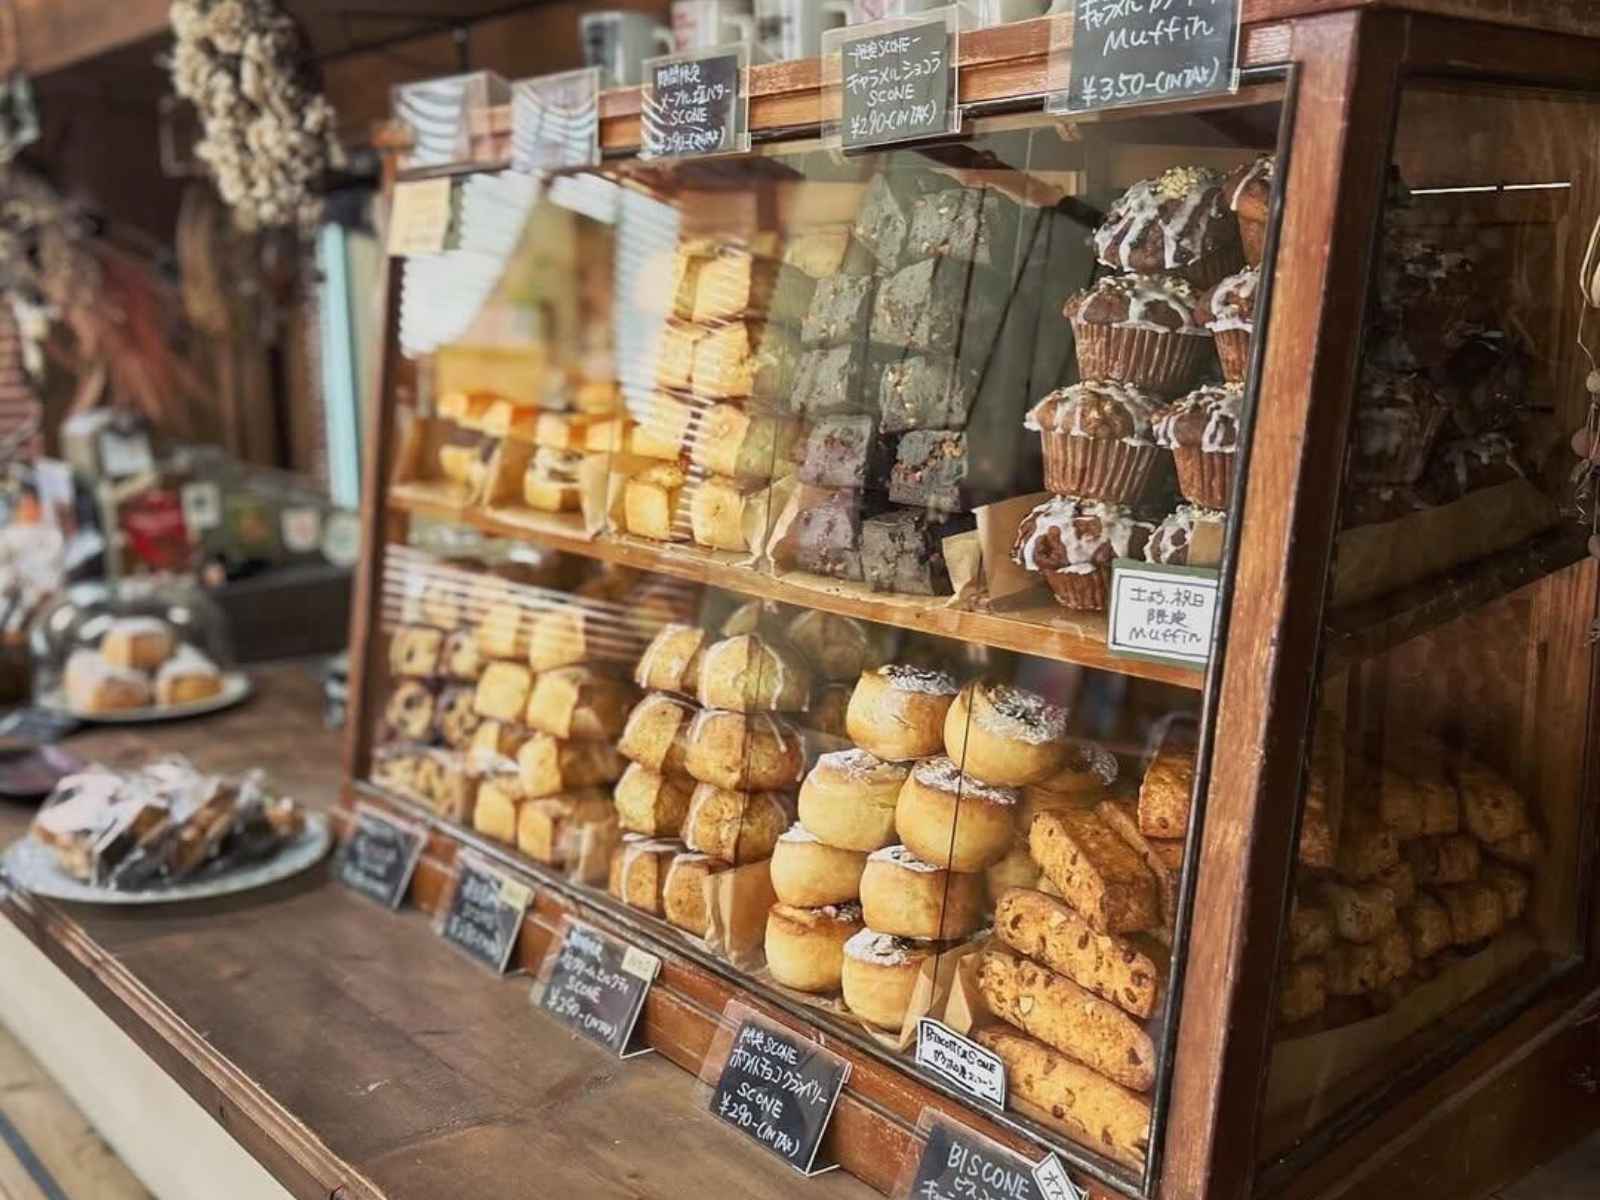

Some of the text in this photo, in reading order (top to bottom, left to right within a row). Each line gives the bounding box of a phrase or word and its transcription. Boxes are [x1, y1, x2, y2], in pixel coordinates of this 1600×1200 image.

[1103, 16, 1214, 56] Muffin
[867, 84, 915, 107] SCONE
[671, 107, 707, 126] SCONE
[1147, 608, 1190, 628] 限定
[737, 1082, 784, 1119] SCONE
[948, 1142, 1029, 1199] BISCONE
